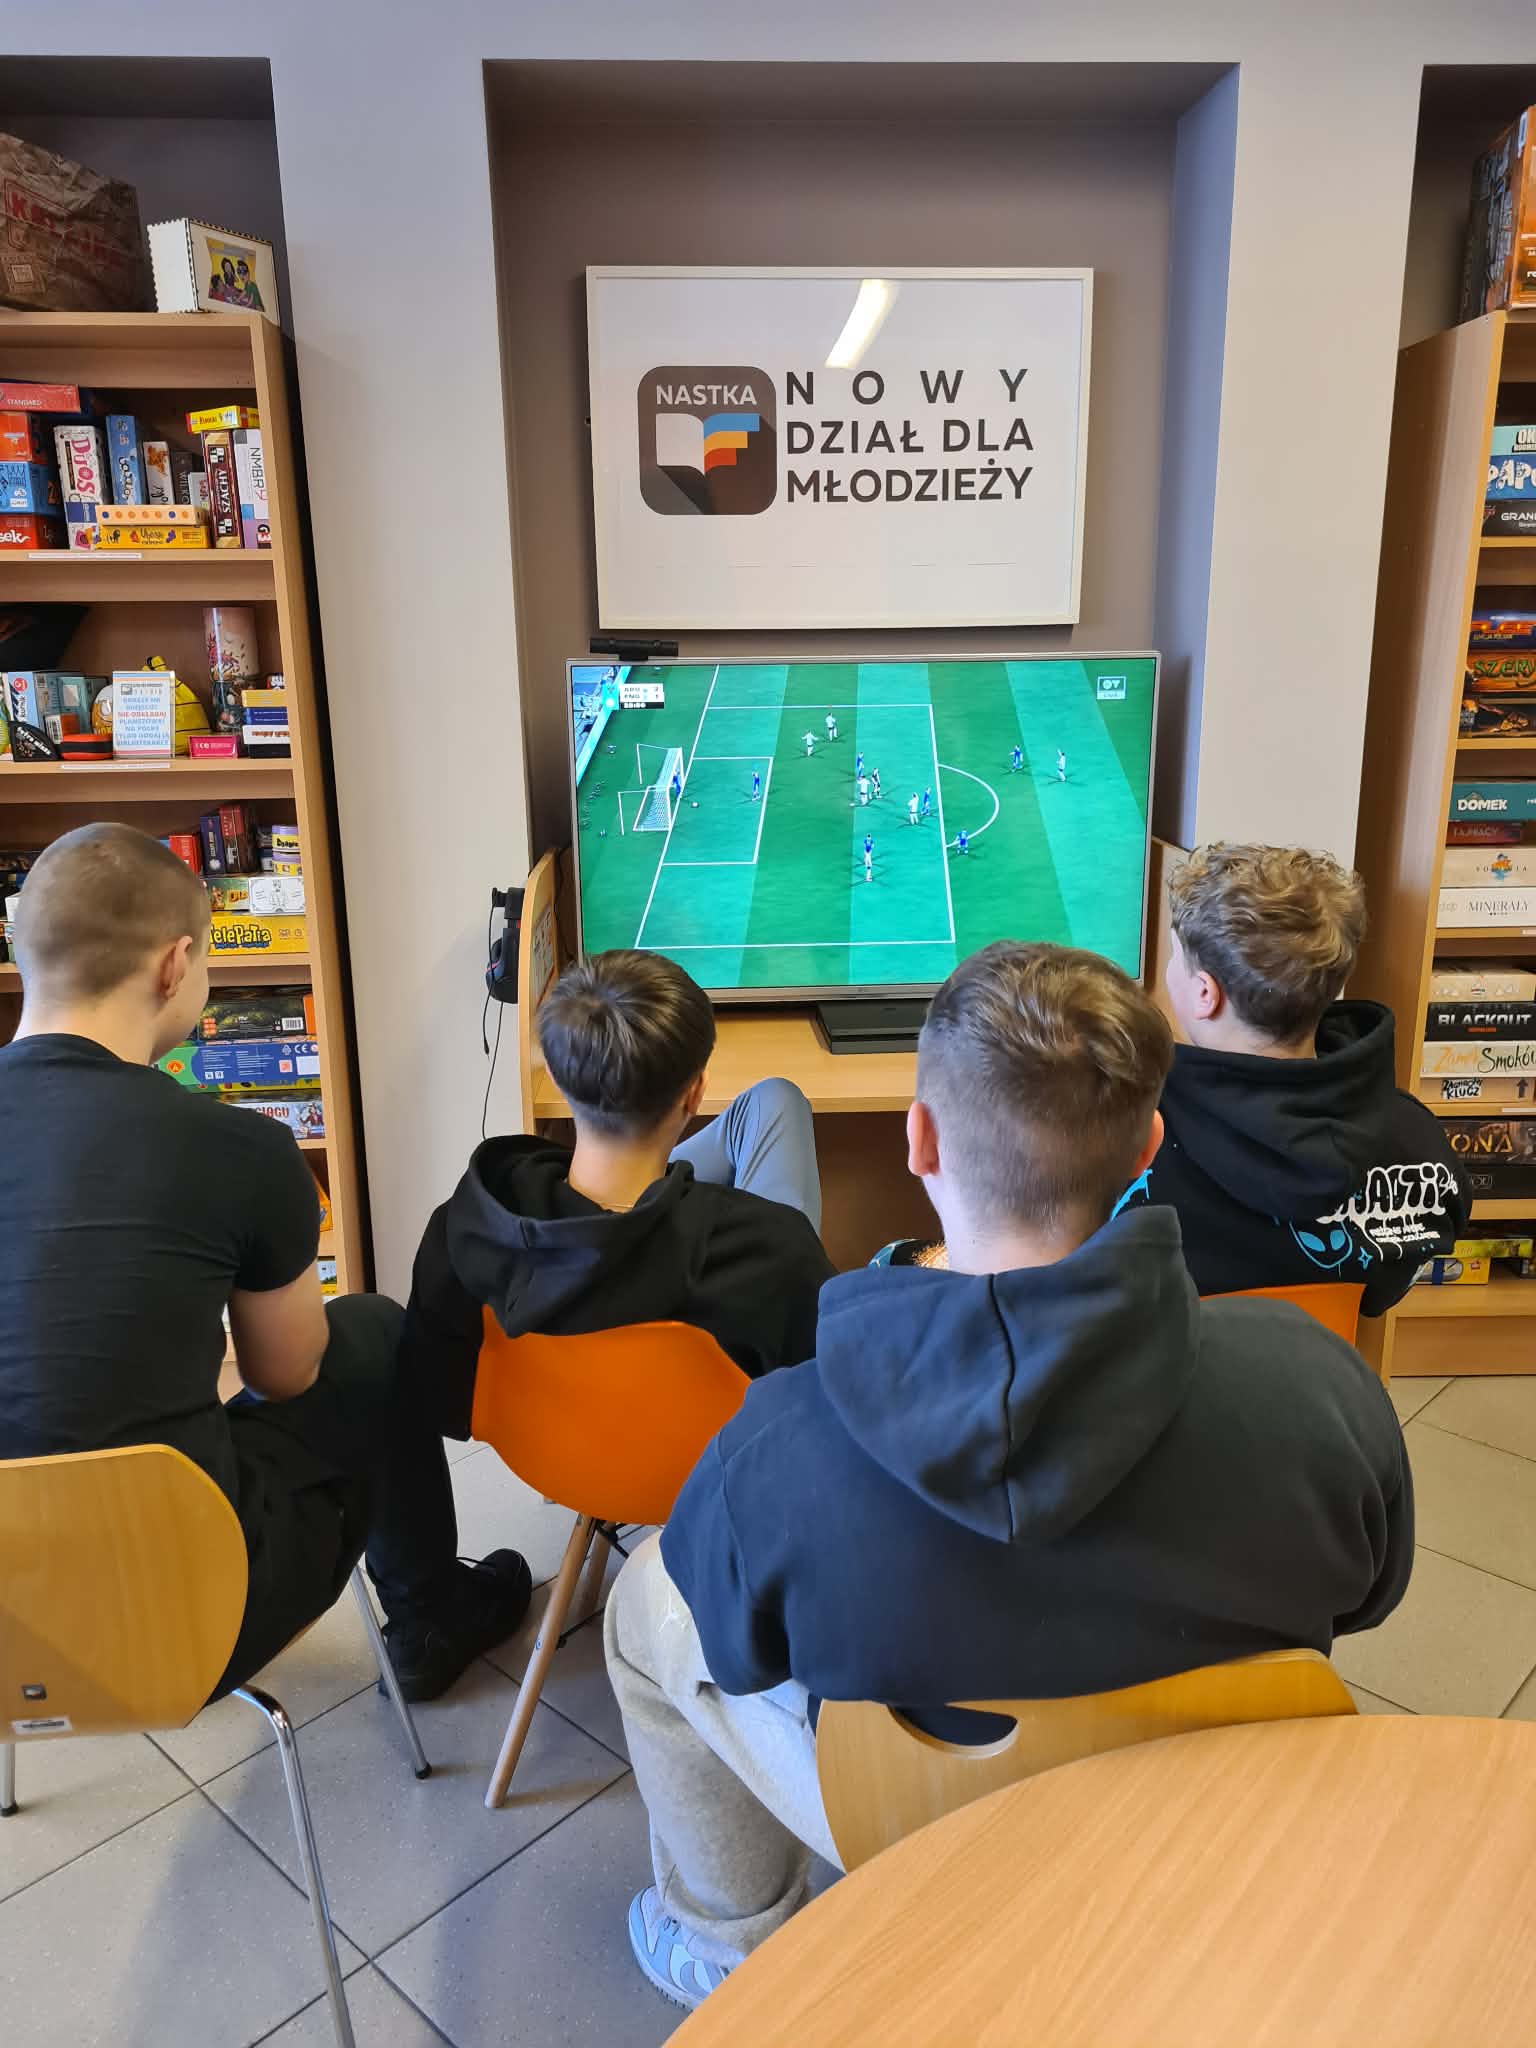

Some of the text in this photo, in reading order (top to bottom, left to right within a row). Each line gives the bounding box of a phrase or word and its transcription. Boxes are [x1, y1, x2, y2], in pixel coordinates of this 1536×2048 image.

[656, 384, 757, 406] NASTKA
[786, 418, 1034, 454] DZIAŁ DLA
[787, 457, 1033, 503] MŁODZIEŻY
[215, 469, 232, 514] SZACHY
[1457, 799, 1508, 811] DOMEK
[1438, 1013, 1532, 1025] BLACKOUT
[1446, 1086, 1480, 1100] KLUCZ
[1445, 1131, 1513, 1153] ONA
